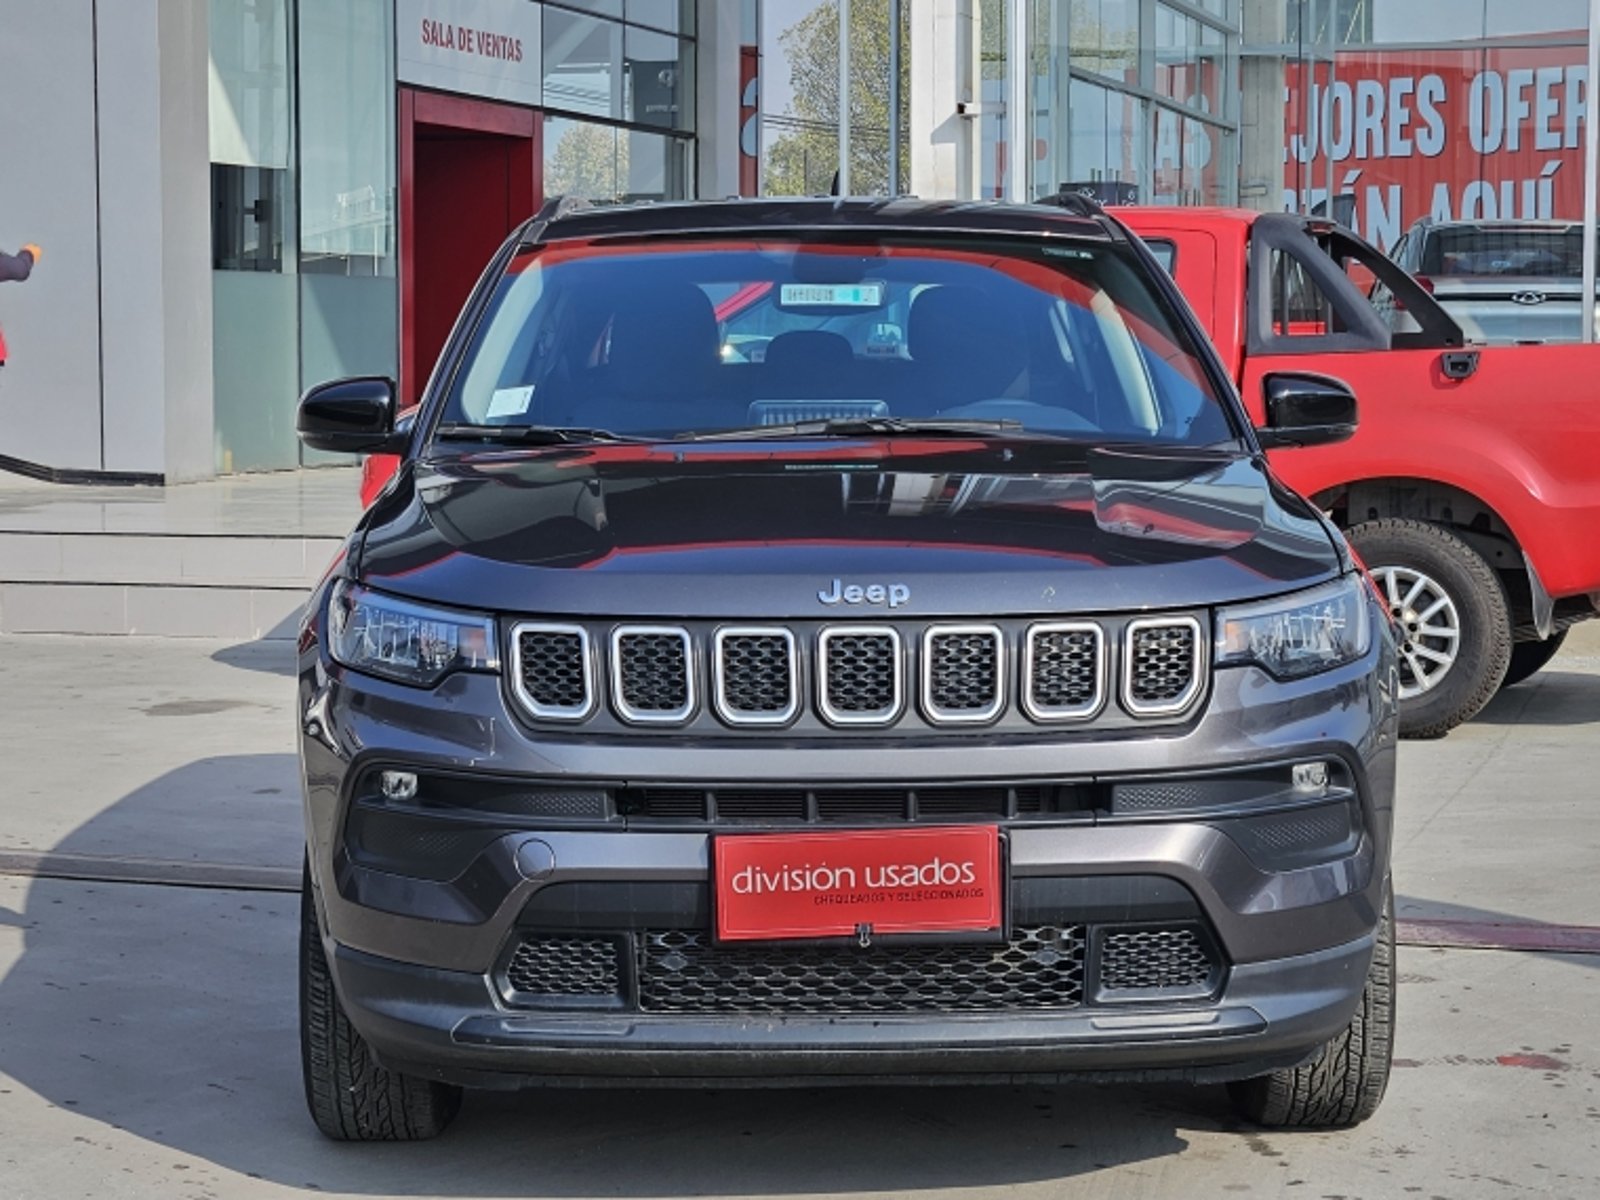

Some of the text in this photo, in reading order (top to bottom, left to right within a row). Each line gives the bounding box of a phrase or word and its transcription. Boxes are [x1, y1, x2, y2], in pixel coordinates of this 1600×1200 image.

[422, 19, 523, 62] SALA DE VENTAS
[817, 578, 911, 608] Jeep
[732, 857, 975, 893] división usados
